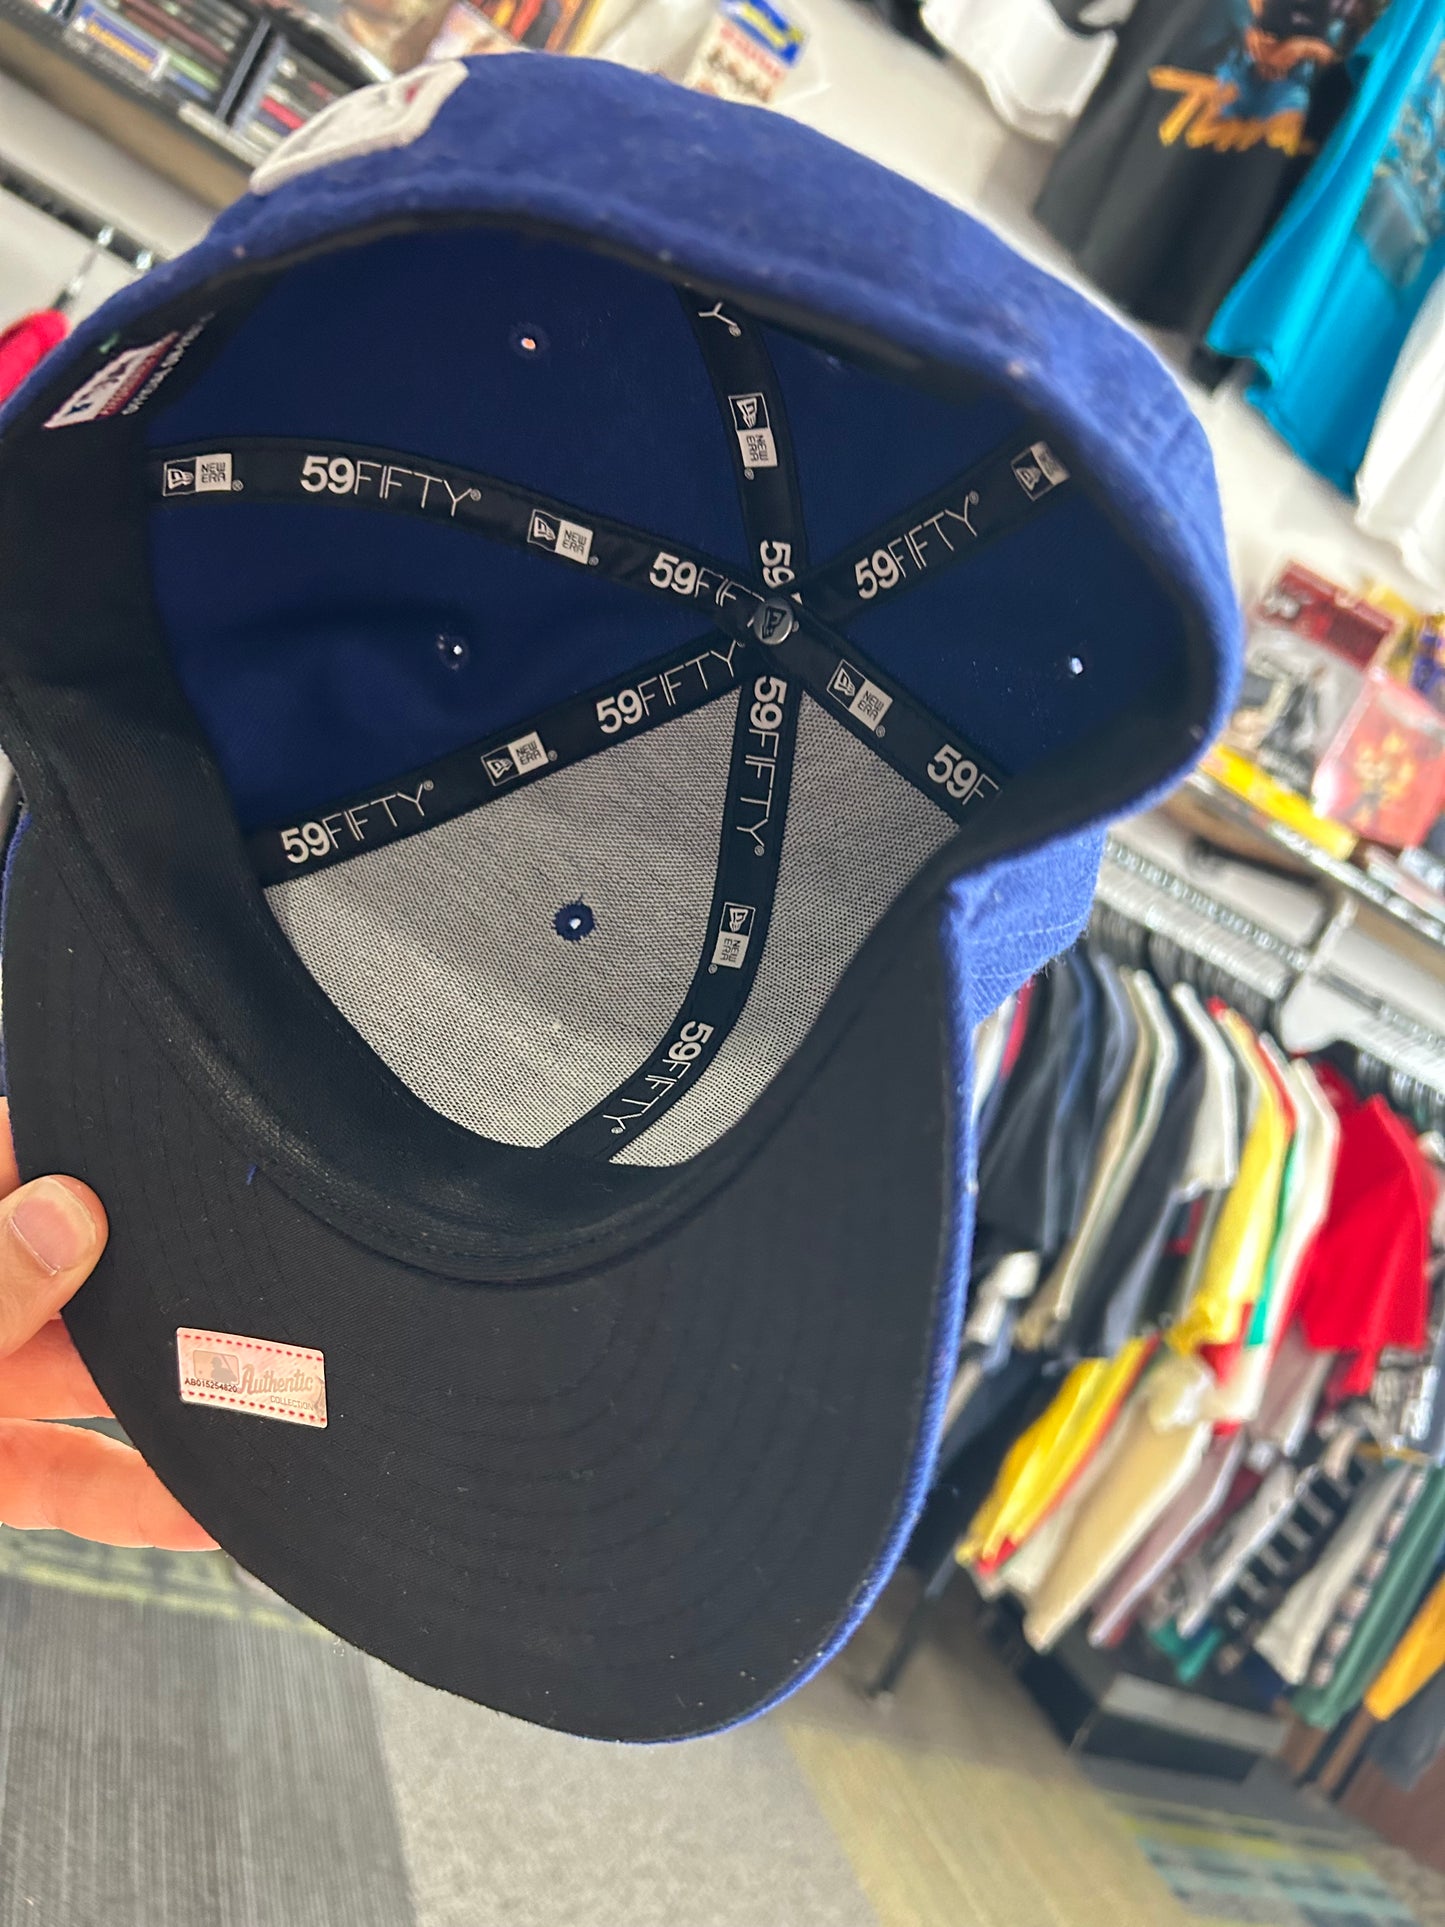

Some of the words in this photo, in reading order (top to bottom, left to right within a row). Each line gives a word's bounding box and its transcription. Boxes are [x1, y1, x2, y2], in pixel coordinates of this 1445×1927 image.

[201, 461, 226, 473] NEW
[201, 472, 226, 483] ERA
[564, 529, 588, 546] NEW
[562, 540, 585, 556] ERA
[863, 690, 884, 712] NEW
[857, 699, 880, 721] ERA
[515, 740, 538, 757] NEW
[520, 749, 543, 766] ERA
[238, 1363, 314, 1395] Authentic
[270, 1395, 314, 1411] COLLECTION
